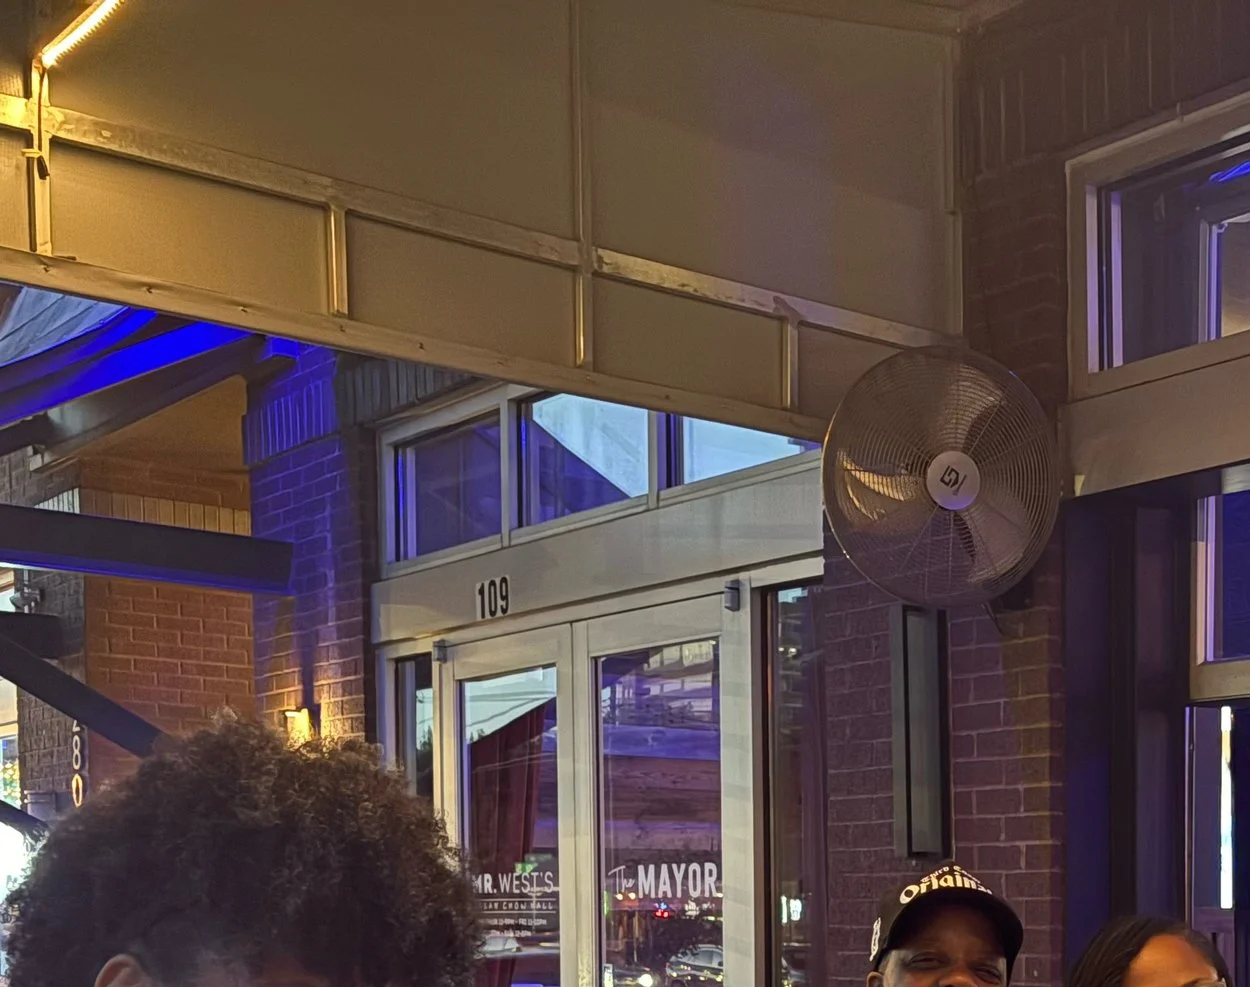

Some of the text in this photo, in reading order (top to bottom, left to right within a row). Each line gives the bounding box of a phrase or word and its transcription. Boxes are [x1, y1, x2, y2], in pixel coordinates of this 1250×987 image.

[478, 576, 509, 619] 109
[498, 871, 554, 893] WEST'S
[608, 862, 718, 898] The MAYOR
